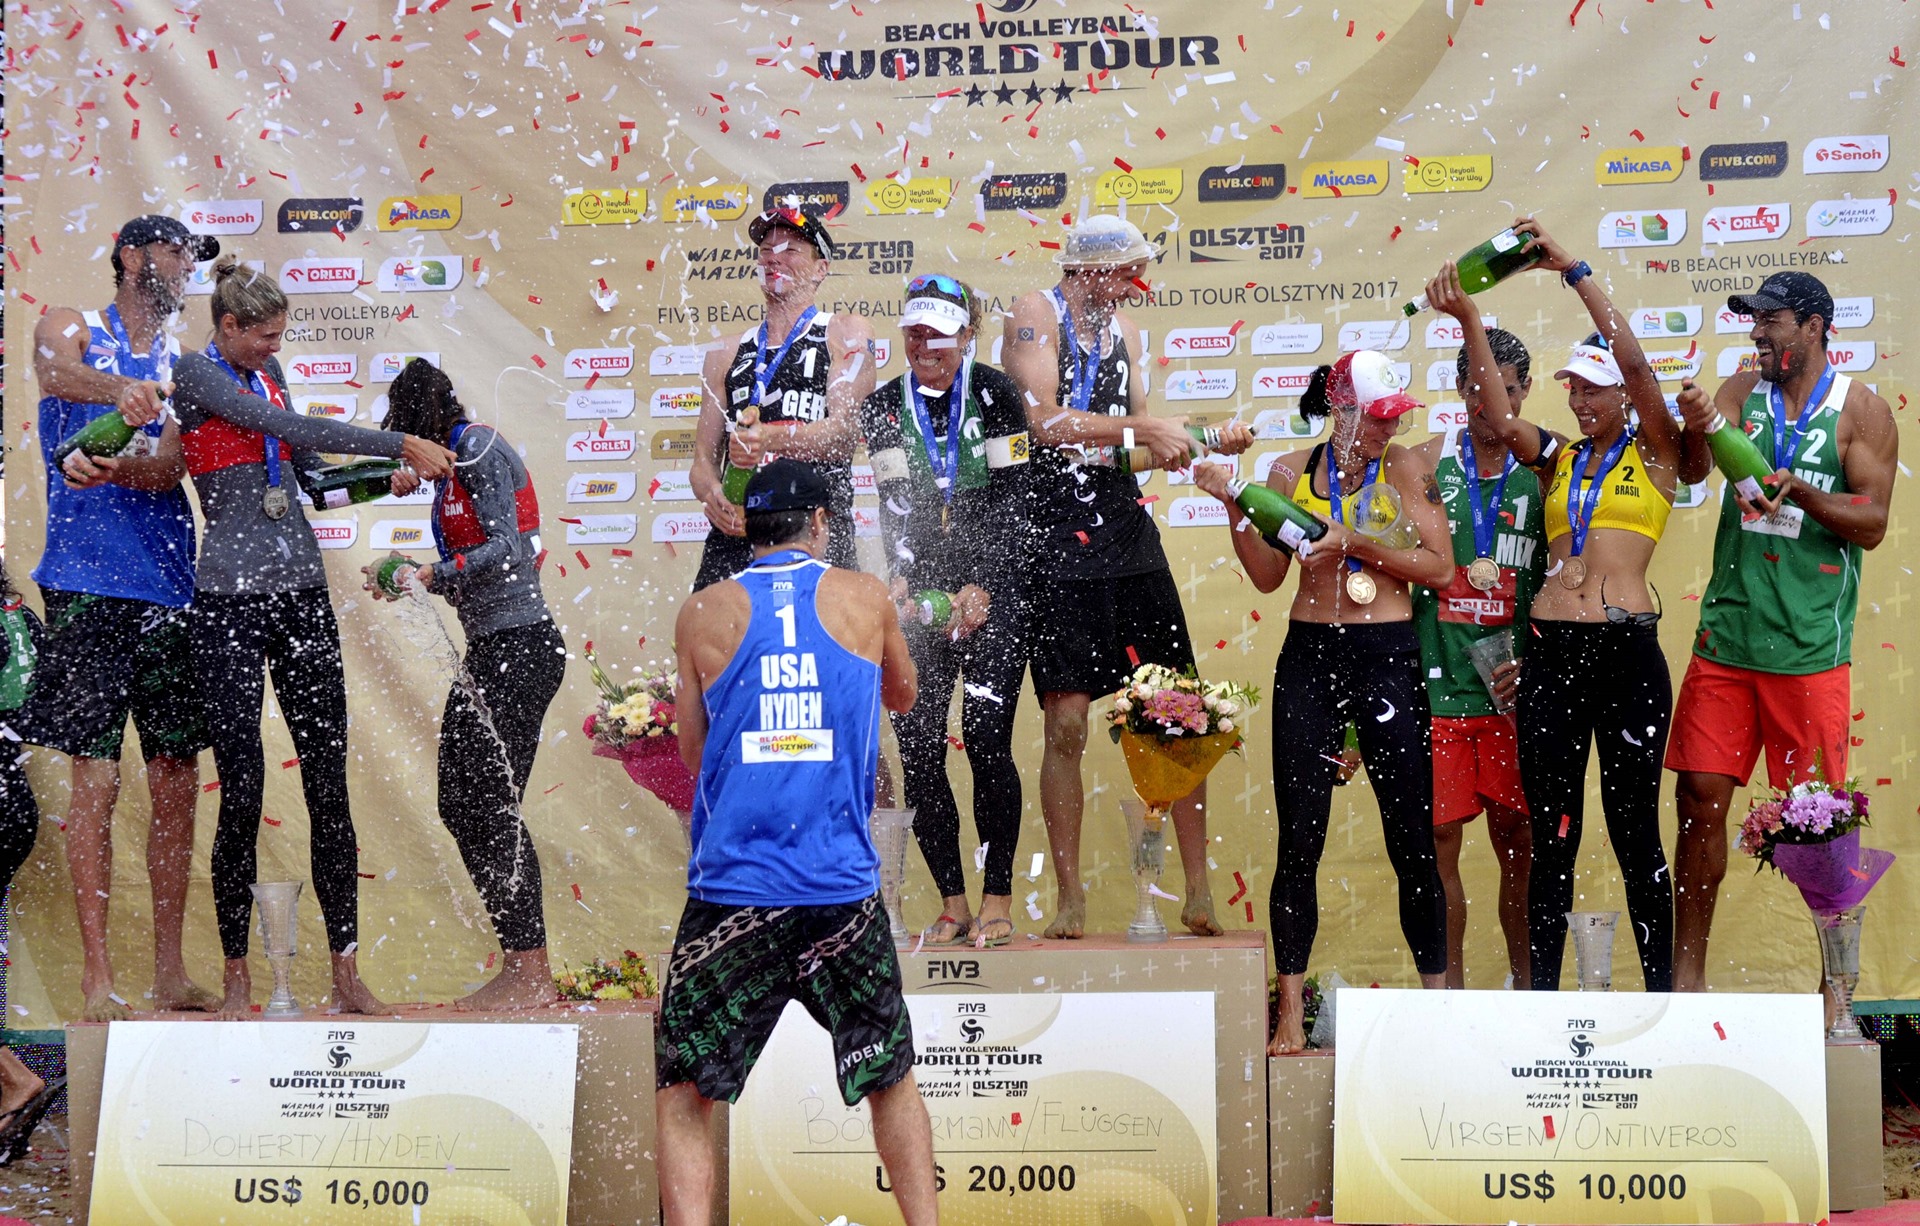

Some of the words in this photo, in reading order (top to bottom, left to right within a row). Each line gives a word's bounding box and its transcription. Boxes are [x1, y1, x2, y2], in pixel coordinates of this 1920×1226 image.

[884, 22, 970, 43] BEACH
[982, 14, 1147, 40] VOLLEYBAL
[817, 42, 1039, 81] WORLD
[1060, 35, 1219, 72] TOUR
[1709, 154, 1777, 168] FIVB.COM
[1830, 149, 1881, 161] Senoh
[1607, 160, 1672, 174] MIKASA
[1208, 176, 1275, 190] FIVB.COM
[1313, 171, 1378, 187] MIKASA
[990, 184, 1056, 197] FIVB.COM
[773, 193, 838, 205] FB.COM
[205, 212, 255, 225] Senoh
[287, 210, 351, 221] FIVB.COM
[1732, 214, 1778, 230] ORLEN
[1189, 225, 1305, 247] OLSZTYN
[688, 246, 759, 263] WARMI
[832, 239, 915, 260] SZTYN
[1259, 244, 1305, 261] 2017
[1686, 256, 1742, 273] BEACH
[1745, 249, 1849, 269] VOLLEYBALL
[308, 268, 354, 281] ORLEN
[687, 264, 758, 281] MAZU
[868, 259, 914, 275] 2017
[1691, 275, 1754, 293] WORLD
[657, 307, 700, 325] FIVB
[707, 304, 767, 323] BEACH
[822, 299, 905, 317] LEYBALL
[1119, 289, 1183, 309] ORLD
[1190, 286, 1247, 306] TOUR
[1253, 282, 1345, 303] OLSZTYN
[1351, 280, 1398, 300] 2017
[286, 306, 315, 322] ACH
[332, 327, 375, 341] TOUR
[1191, 337, 1230, 349] ORLEN
[312, 362, 350, 374] ORLEN
[591, 357, 628, 369] ORLEN
[801, 347, 818, 379] 1
[1652, 364, 1693, 373] USZYŃSKI
[1116, 359, 1129, 397] 2
[1196, 378, 1226, 386] WRMIA
[1279, 375, 1310, 387] ORLE
[308, 406, 332, 417] RM
[659, 400, 703, 410] PRUSZYN
[781, 389, 828, 422] GER
[1751, 410, 1768, 419] FIVB
[592, 441, 629, 451] ORLEN
[1801, 428, 1828, 465] 2
[1272, 461, 1296, 482] SSAN
[1622, 465, 1635, 483] 2
[672, 482, 692, 490] Lease
[850, 477, 874, 486] ORLE
[588, 483, 616, 494] RMF
[1614, 484, 1641, 499] BRASIL
[444, 501, 464, 517] CAN
[1198, 505, 1226, 513] POLSK
[1198, 511, 1228, 519] SIATKÓWK
[1512, 494, 1529, 531] 1
[313, 529, 349, 538] ORLEN
[393, 530, 420, 541] RMF
[682, 527, 710, 535] SIATKÓWK
[1495, 532, 1538, 570] MEX
[775, 604, 797, 647] 1
[760, 652, 819, 690] USA
[759, 691, 823, 732] HYDEN
[759, 734, 799, 743] BLACHY
[927, 960, 981, 979] FIVB
[957, 1003, 986, 1013] FIVB
[1567, 1019, 1596, 1029] FIVB
[327, 1030, 355, 1040] FIVB
[984, 1053, 1043, 1065] TOUR
[1511, 1067, 1590, 1078] WORLD
[1594, 1067, 1653, 1079] TOUR
[269, 1077, 345, 1089] WORLD
[350, 1078, 406, 1090] TOUR
[917, 1081, 961, 1089] WARMIA
[972, 1080, 1028, 1090] OLSZTYN
[1582, 1093, 1638, 1102] OLSZTYN
[281, 1102, 324, 1110] WARMIA
[335, 1103, 390, 1112] OLSZTYN
[184, 1118, 461, 1172] DOHERTY/HYDEN
[876, 1161, 947, 1197] U$
[968, 1164, 1076, 1196] 20,000
[234, 1175, 303, 1207] US$
[325, 1179, 430, 1210] 16,000
[1484, 1169, 1556, 1203] US$
[1578, 1173, 1687, 1204] 10,000
